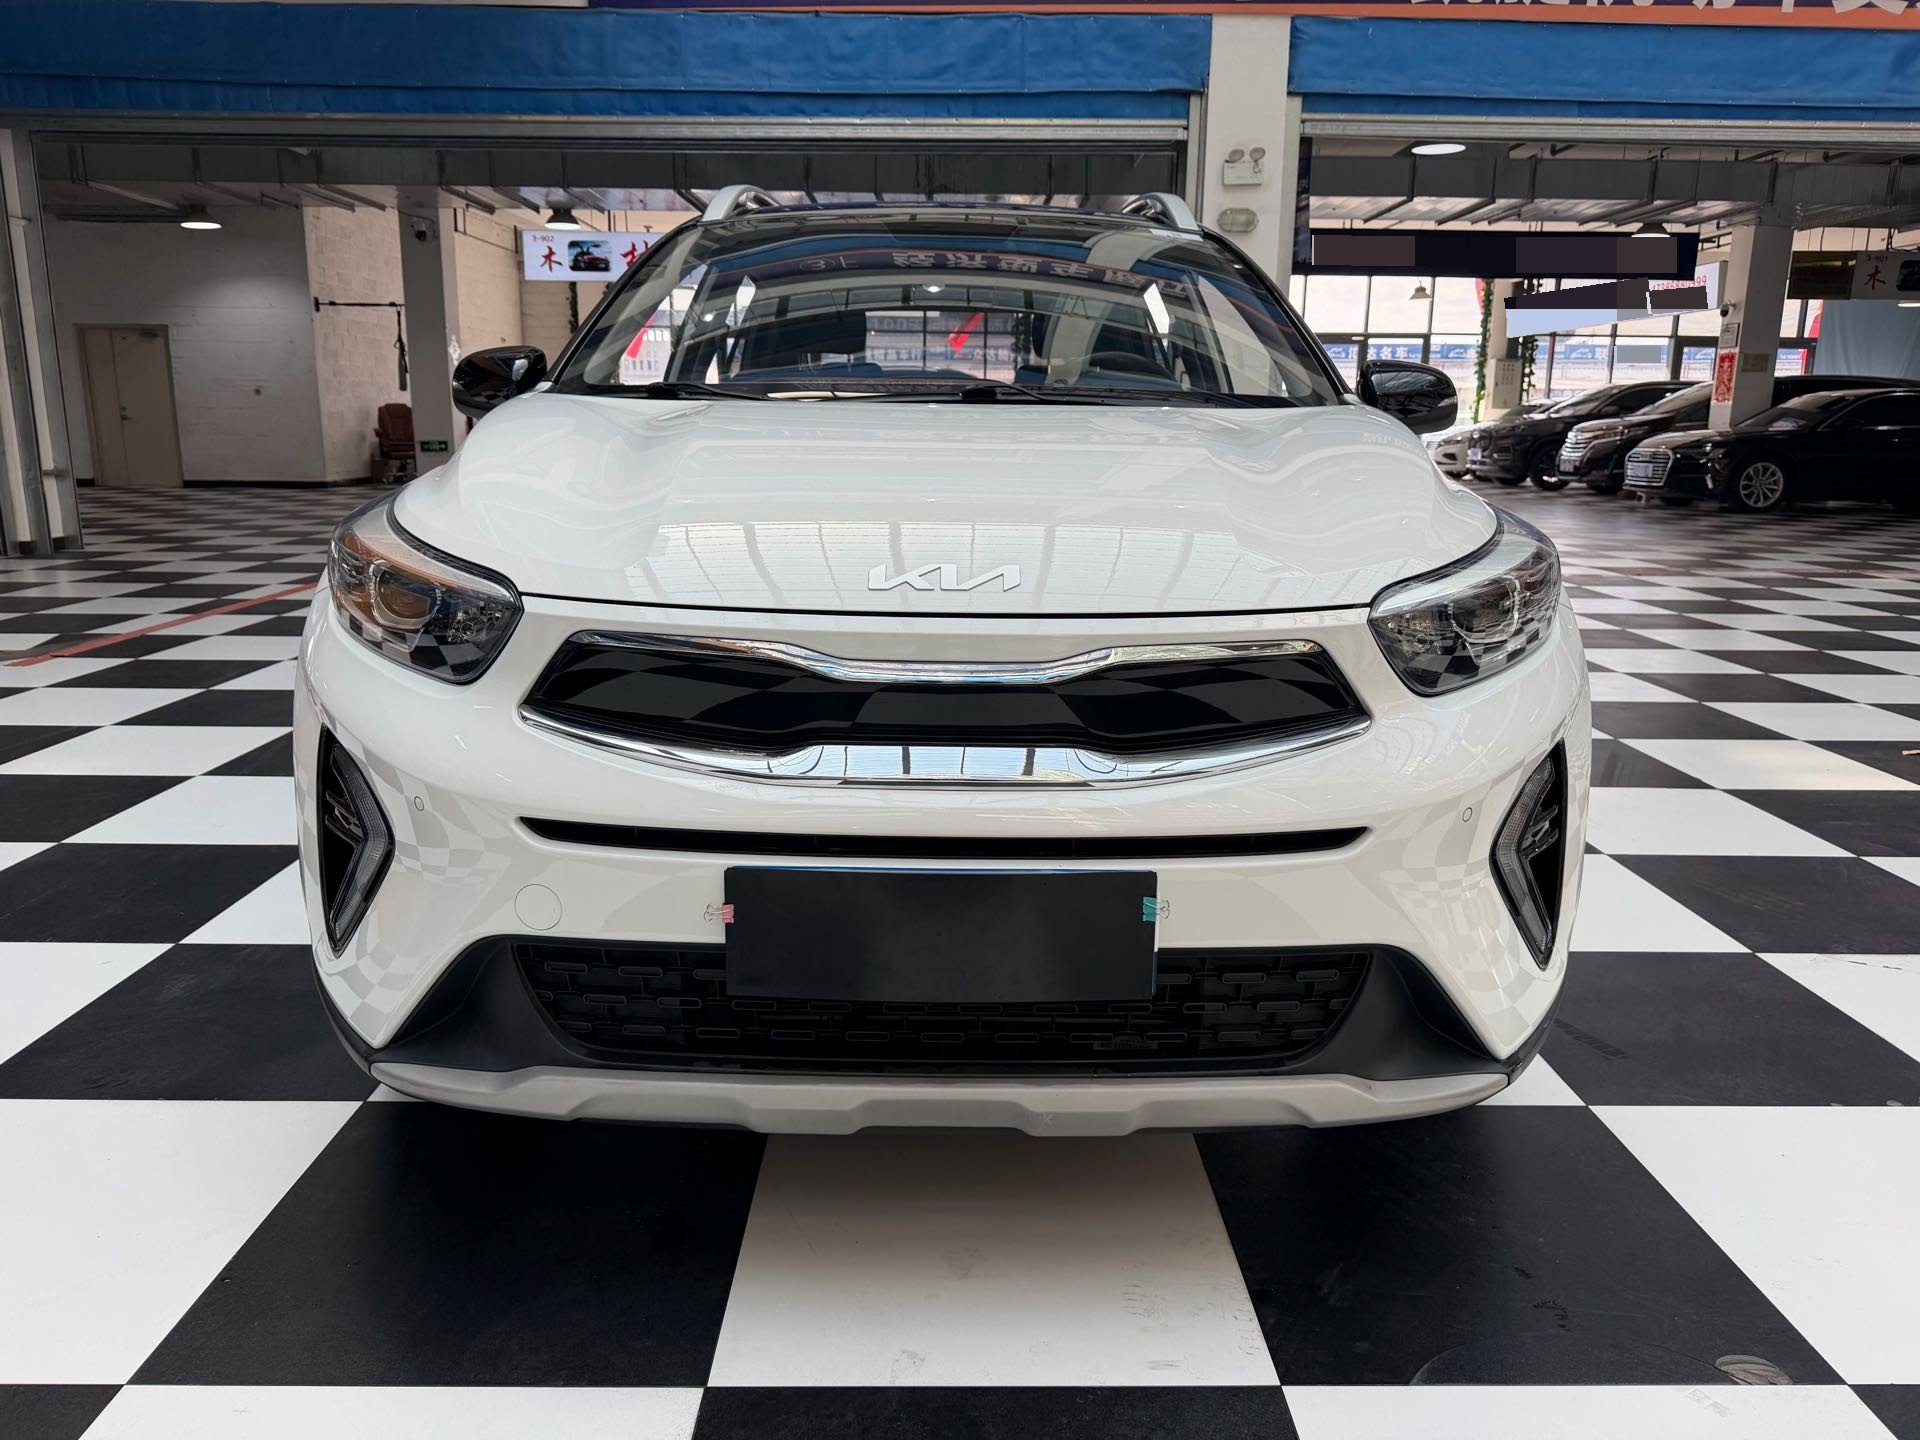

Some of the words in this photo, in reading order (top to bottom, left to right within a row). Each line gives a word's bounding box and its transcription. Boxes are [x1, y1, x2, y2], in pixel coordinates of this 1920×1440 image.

[540, 245, 563, 272] 木
[1864, 265, 1886, 290] 木
[868, 563, 1021, 592] KIA
